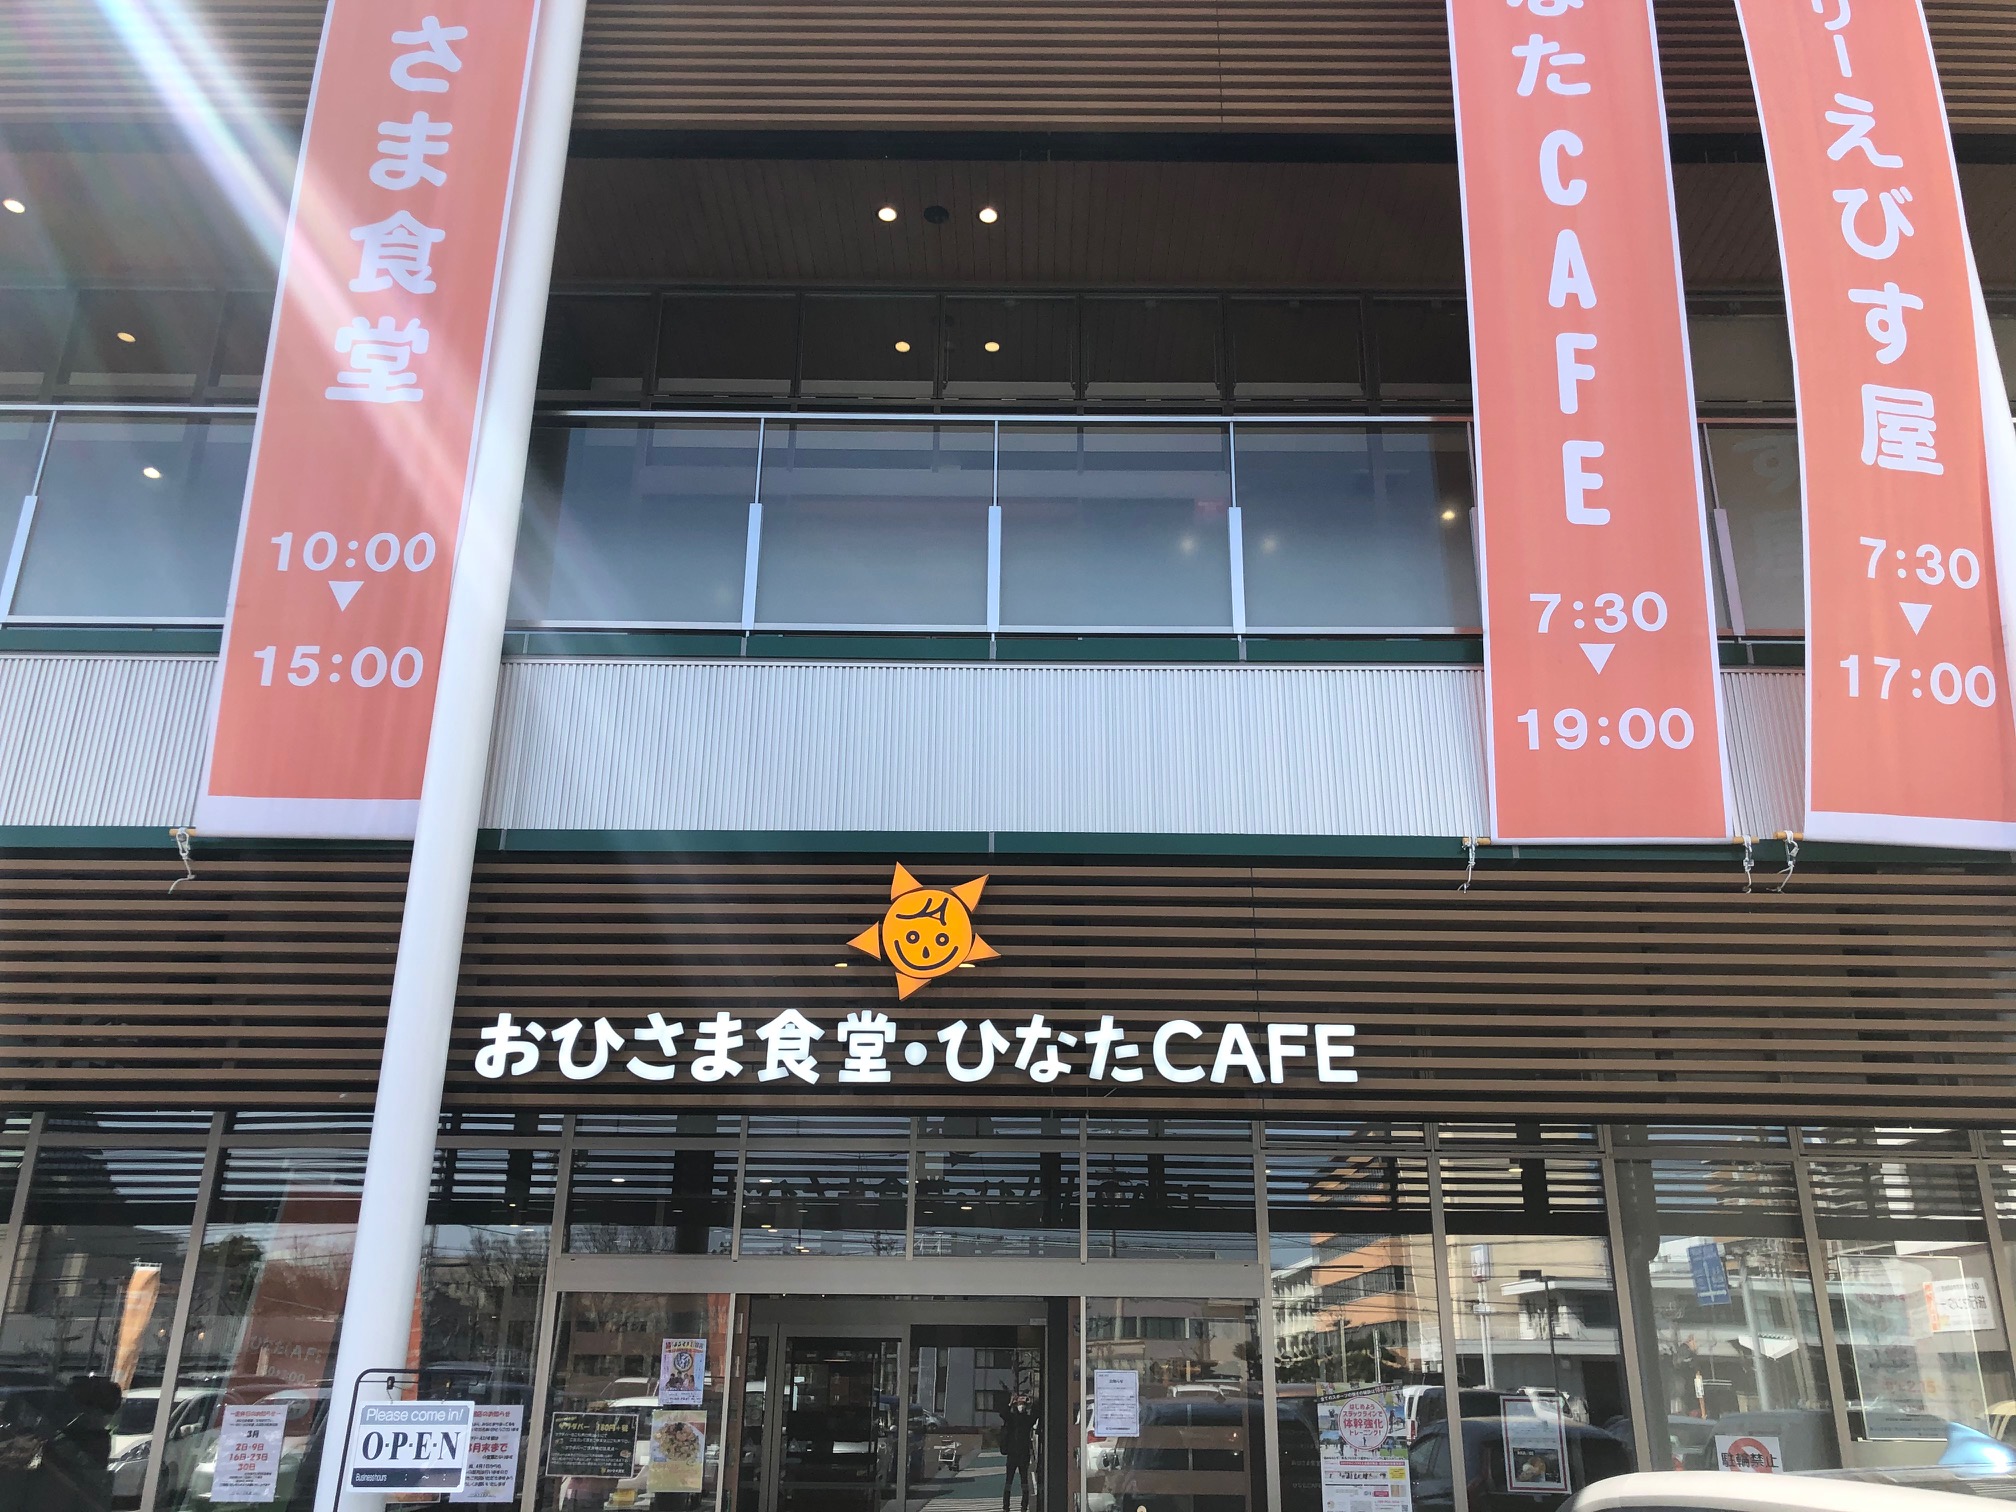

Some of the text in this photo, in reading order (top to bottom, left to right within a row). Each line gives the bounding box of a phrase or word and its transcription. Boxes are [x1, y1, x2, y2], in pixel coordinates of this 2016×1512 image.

[324, 15, 468, 403] さま食堂
[1506, 0, 1612, 527] たCAFE
[270, 530, 436, 573] 10:00
[1860, 536, 1981, 590] 7:30
[1529, 591, 1668, 634] 7:30
[253, 645, 424, 688] 15:00
[1839, 653, 1997, 708] 17:00
[1517, 707, 1695, 750] 19:00
[366, 1408, 464, 1422] Please come in!
[1343, 1410, 1383, 1418] スラックラインで
[1343, 1418, 1384, 1429] 体幹強化
[1721, 1452, 1779, 1468] 駐輪禁止
